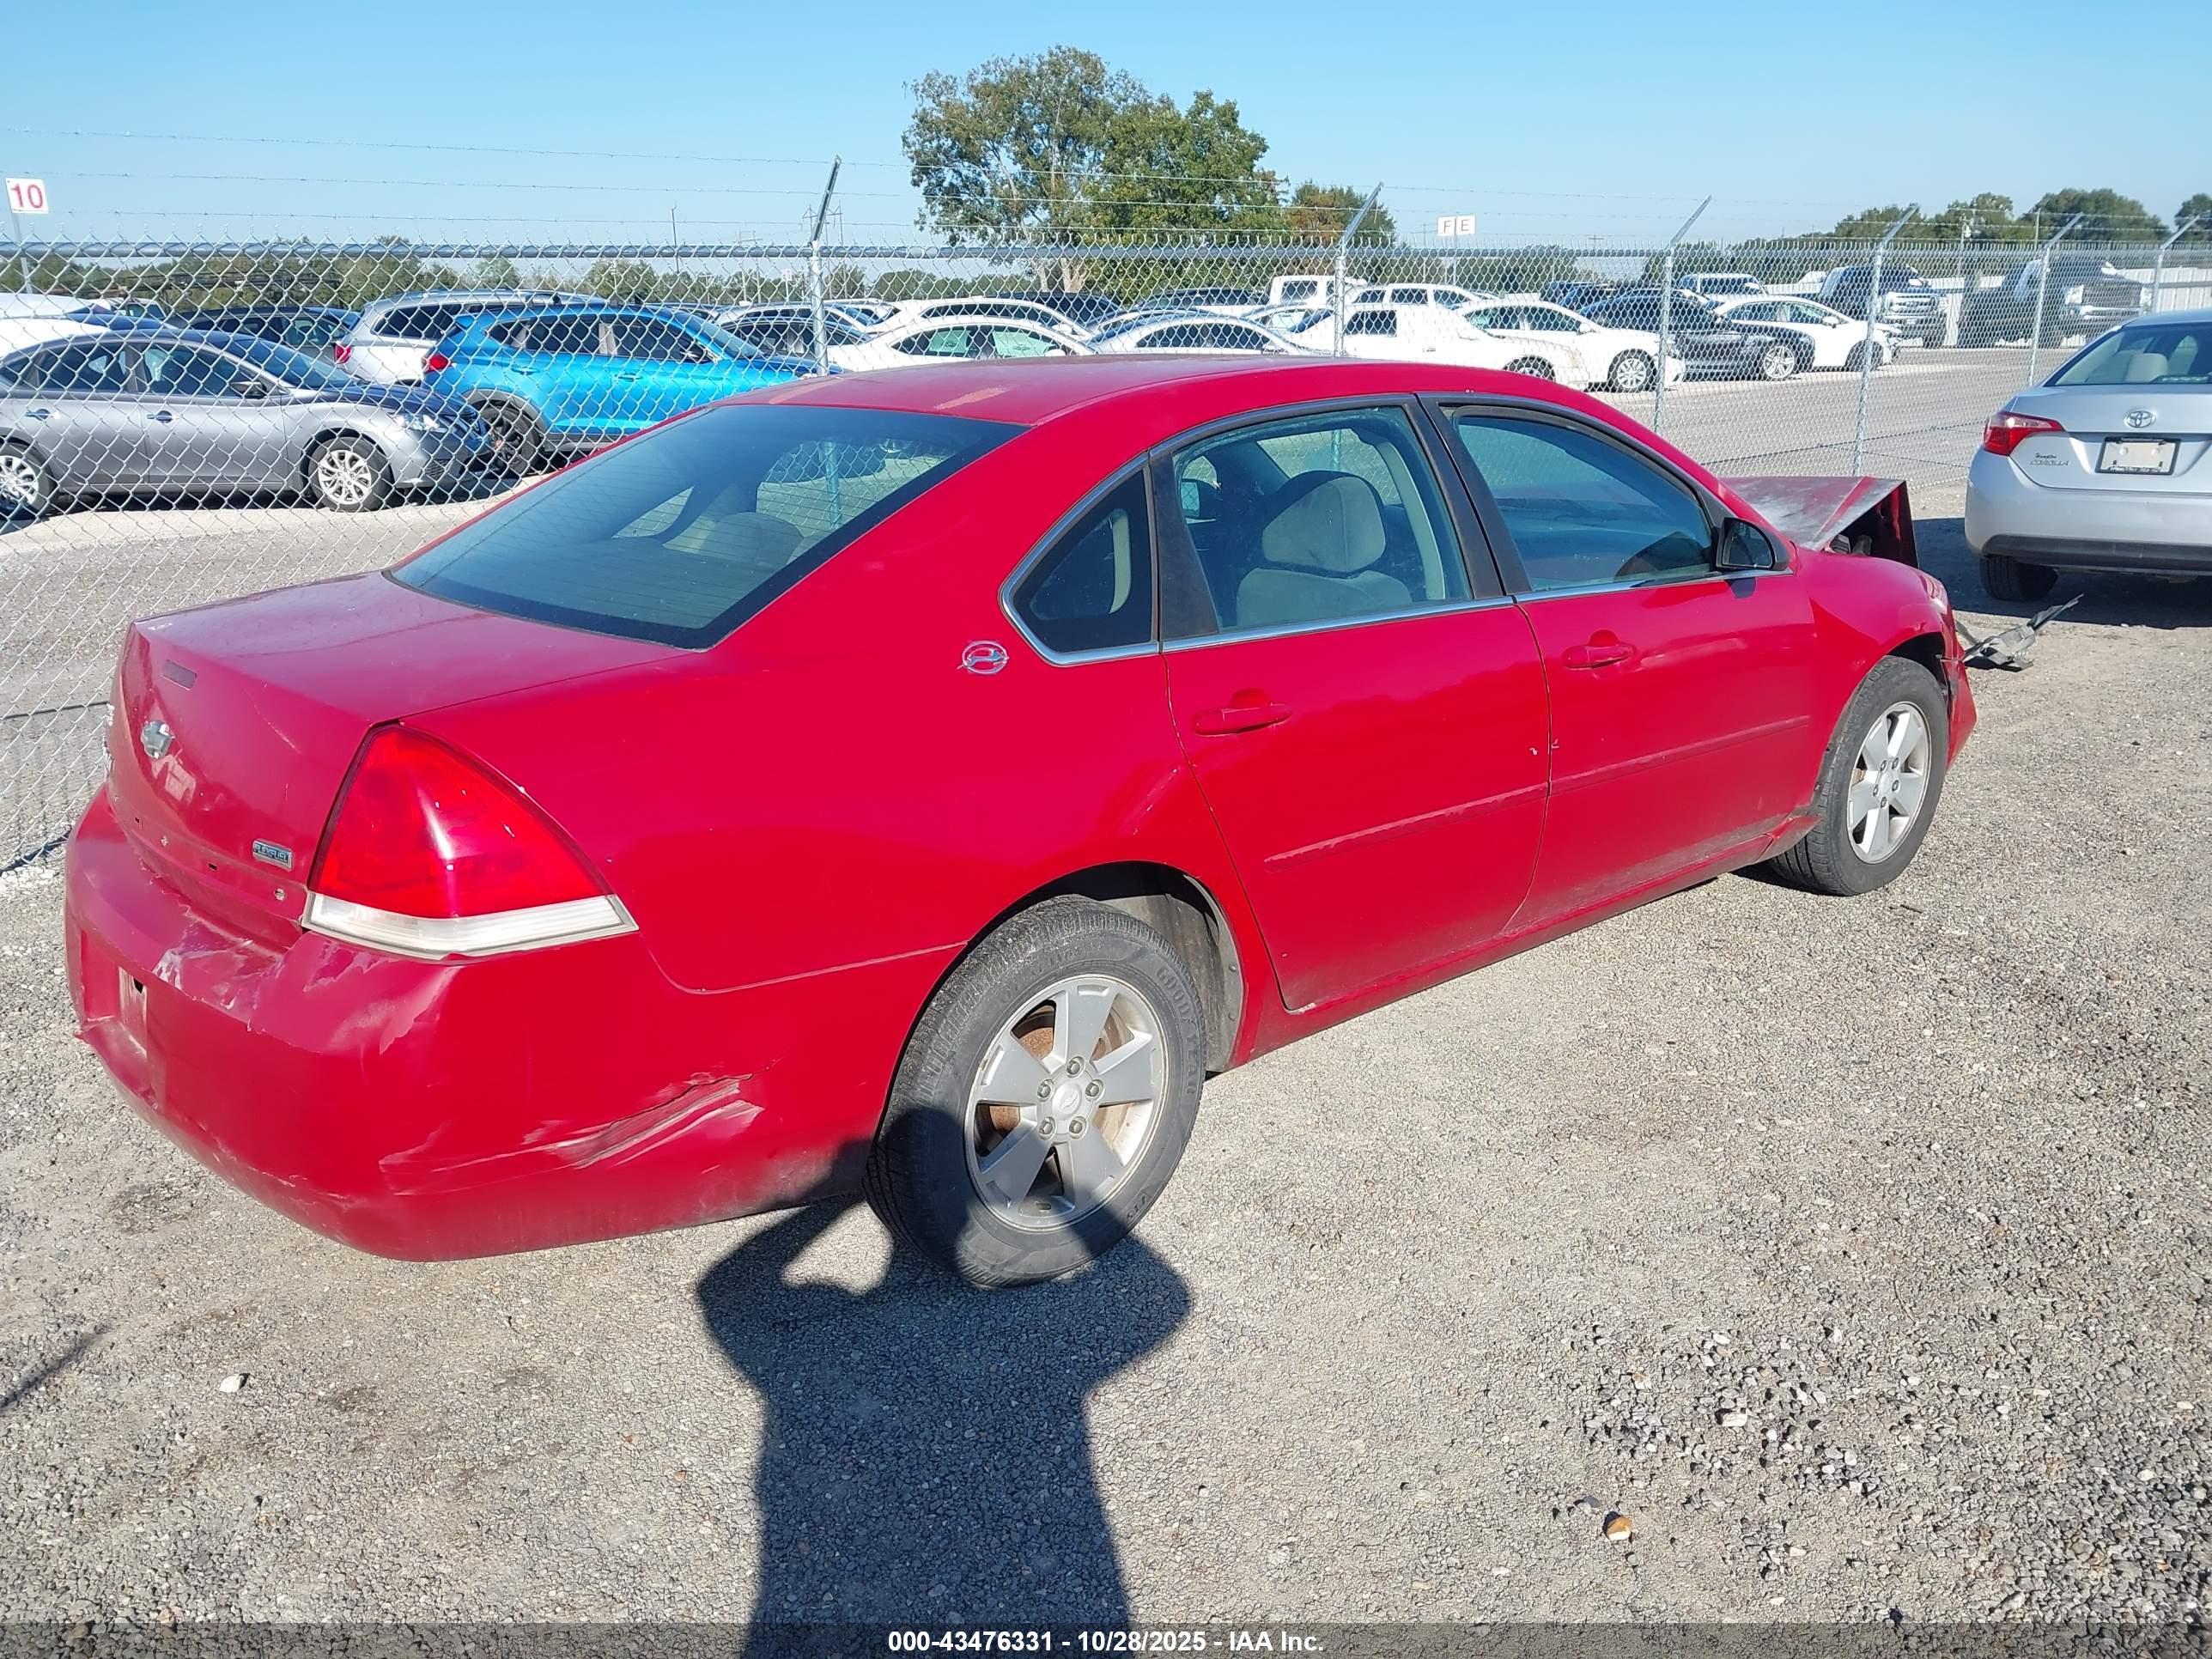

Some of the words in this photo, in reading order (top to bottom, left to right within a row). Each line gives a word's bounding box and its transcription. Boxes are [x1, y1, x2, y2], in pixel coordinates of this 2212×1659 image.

[10, 183, 43, 209] 10
[1443, 220, 1453, 234] F
[1461, 219, 1470, 232] E
